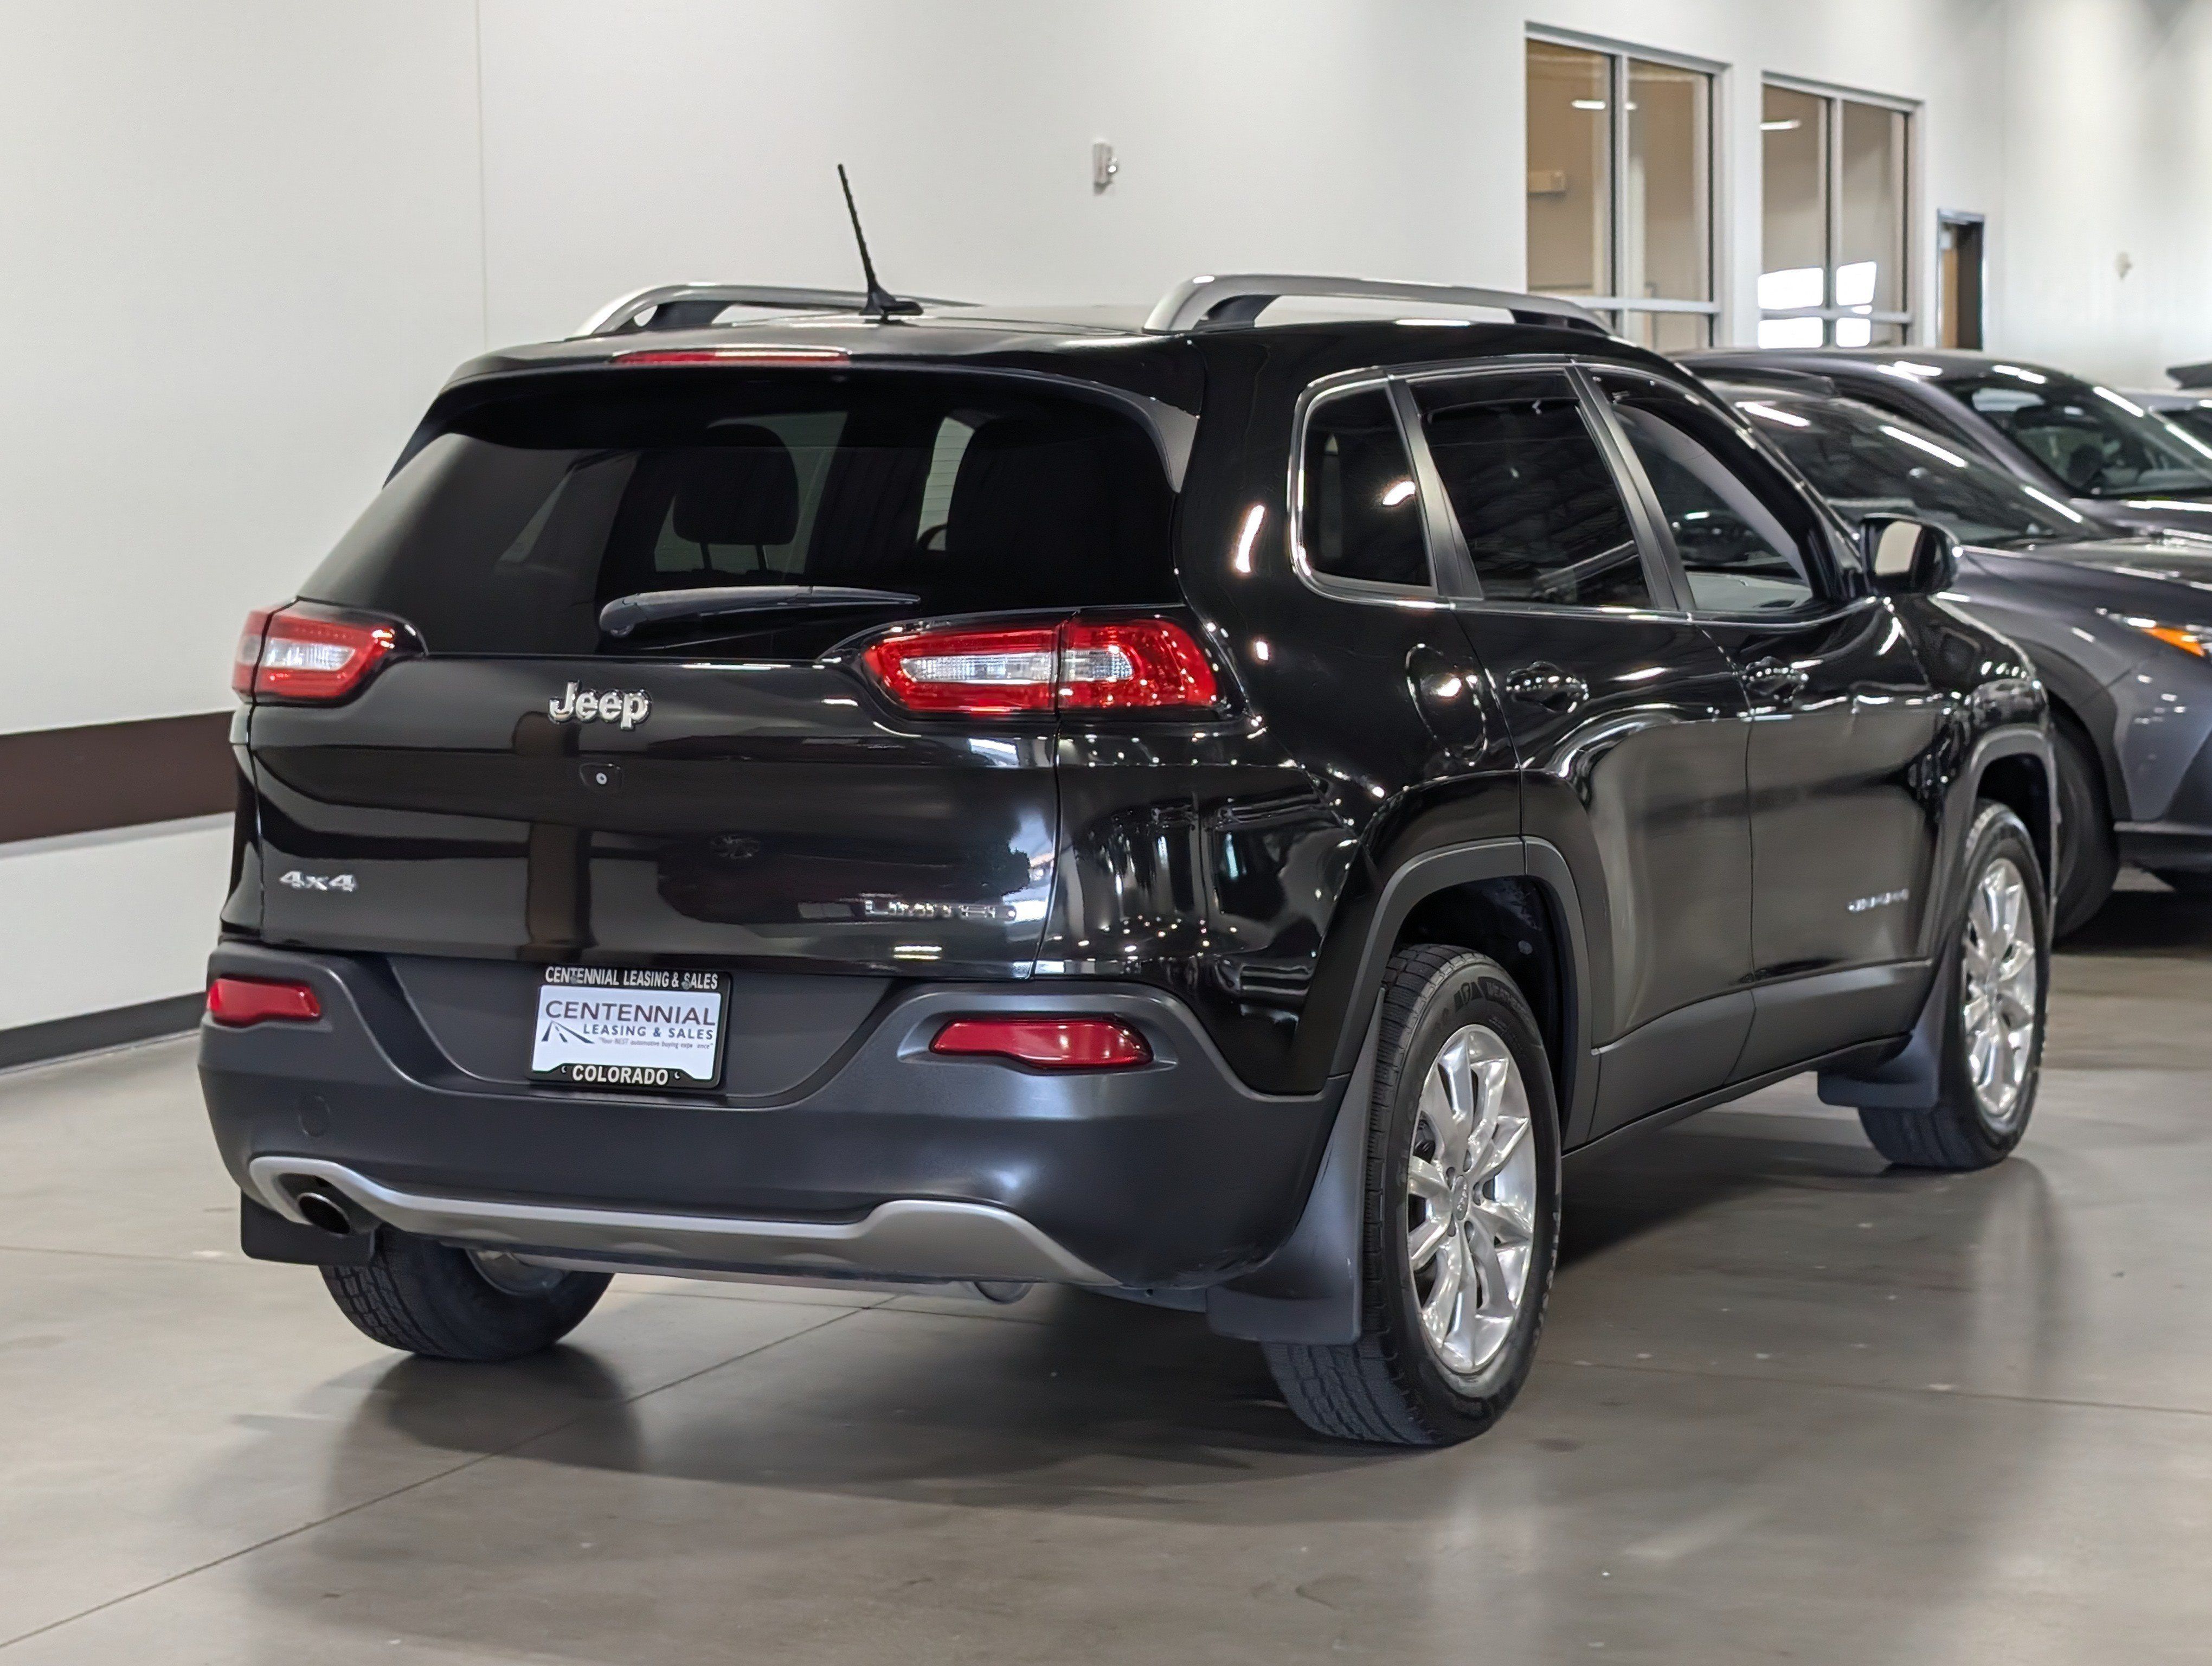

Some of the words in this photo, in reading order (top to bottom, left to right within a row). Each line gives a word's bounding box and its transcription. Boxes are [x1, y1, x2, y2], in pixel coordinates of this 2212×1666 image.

[549, 680, 652, 731] Jeep
[545, 965, 620, 986] CENTENNIAL
[623, 970, 669, 988] LEASING
[671, 971, 679, 988] &
[682, 972, 718, 990] SALES
[545, 1000, 716, 1026] CENTENNIAL
[583, 1024, 647, 1037] LEASING
[652, 1027, 661, 1037] &
[668, 1028, 713, 1040] SALES
[661, 1041, 679, 1049] buying
[573, 1065, 669, 1086] COLORADO
